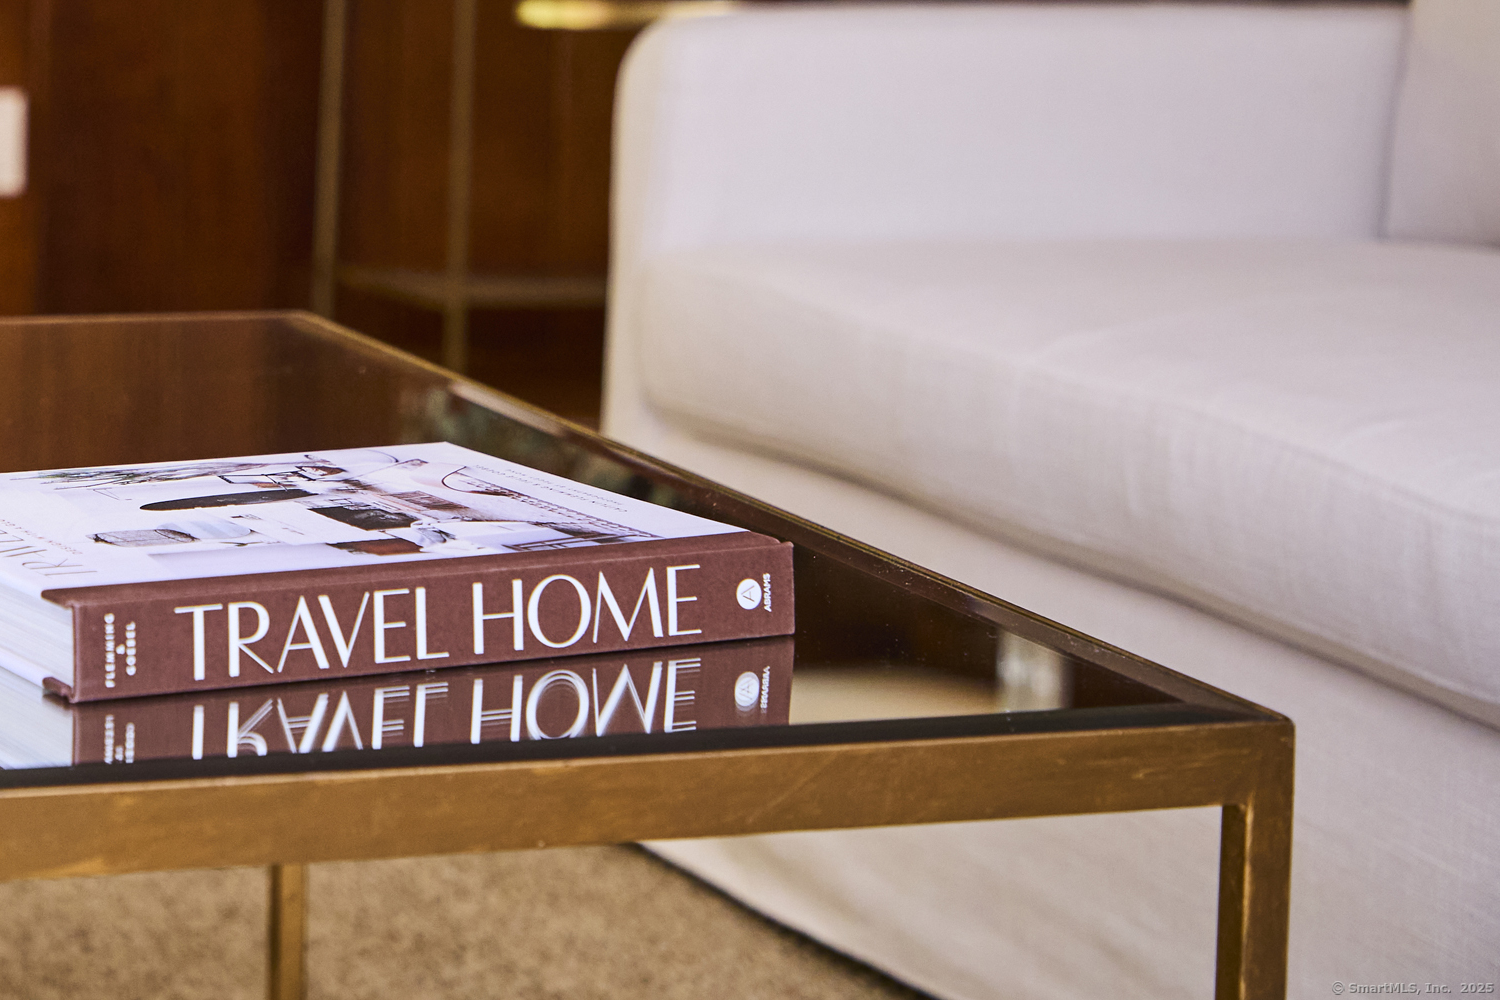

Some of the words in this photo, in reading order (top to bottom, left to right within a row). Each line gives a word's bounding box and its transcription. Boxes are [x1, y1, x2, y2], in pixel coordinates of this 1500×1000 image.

[174, 586, 449, 681] TRAVEL
[472, 564, 702, 655] HOME
[762, 572, 772, 612] ABRAMS
[103, 612, 116, 688] FLEMMING
[125, 621, 137, 676] GOEBEL
